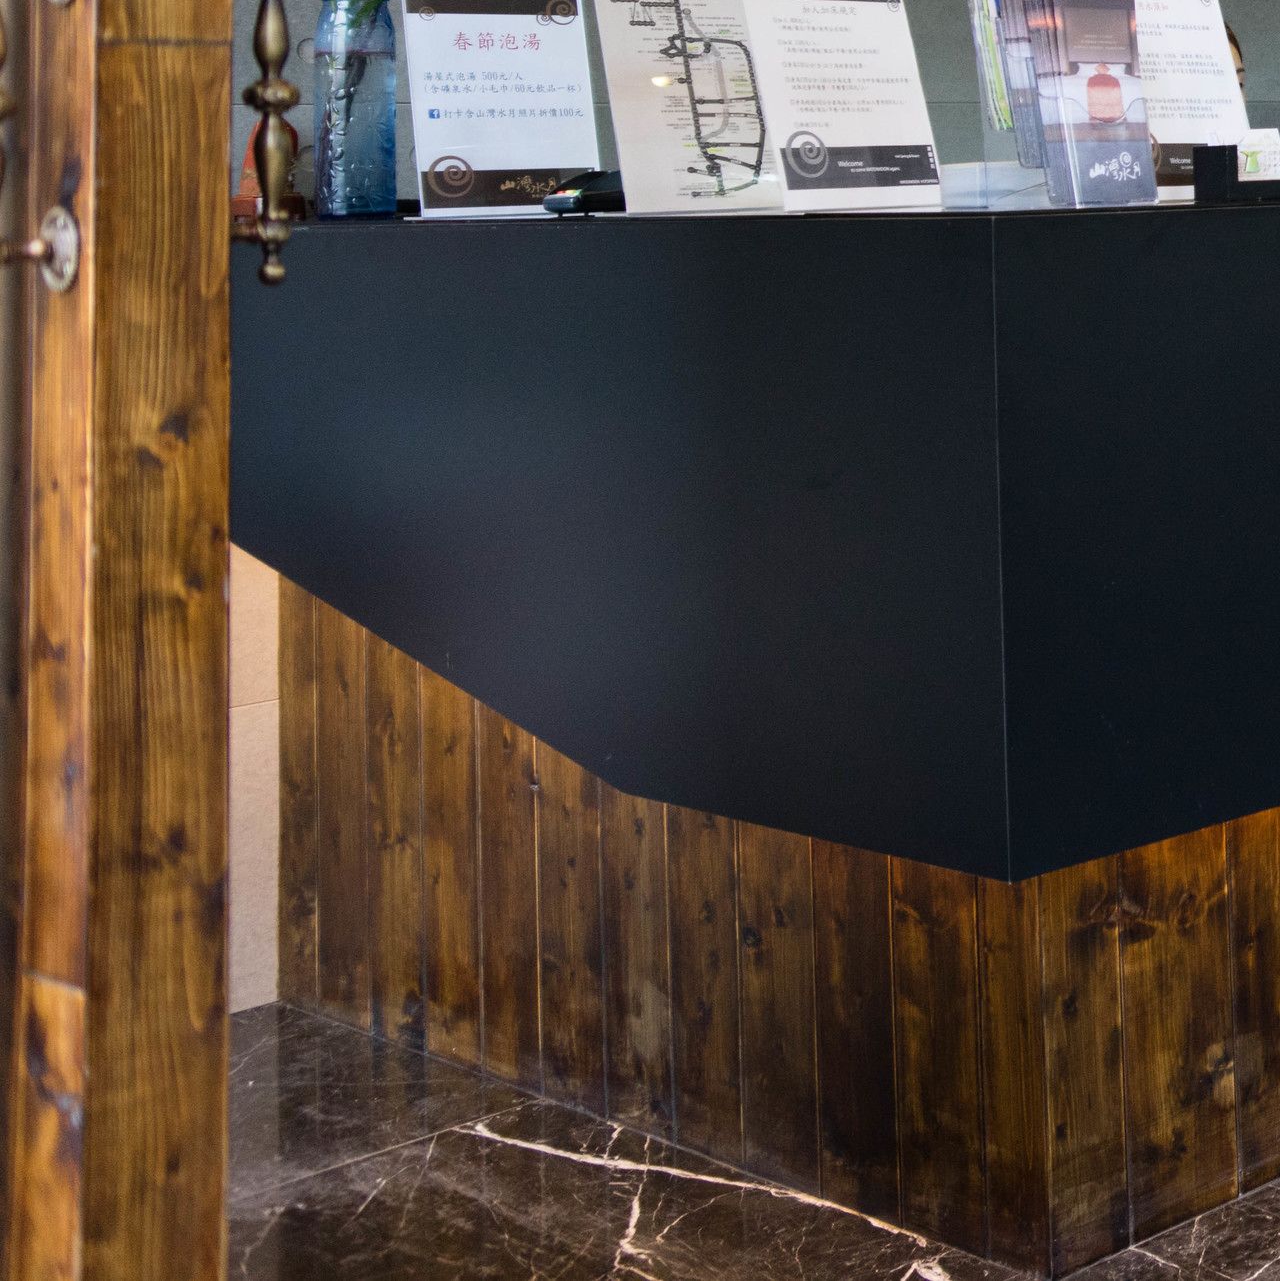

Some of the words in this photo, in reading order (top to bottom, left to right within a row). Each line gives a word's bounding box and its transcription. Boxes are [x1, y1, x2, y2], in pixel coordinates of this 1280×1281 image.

[453, 31, 541, 51] 春節泡湯
[482, 71, 523, 81] 500元/人
[837, 160, 863, 168] Welcome
[1169, 157, 1191, 165] Welcome
[1089, 159, 1141, 180] 山灣水月
